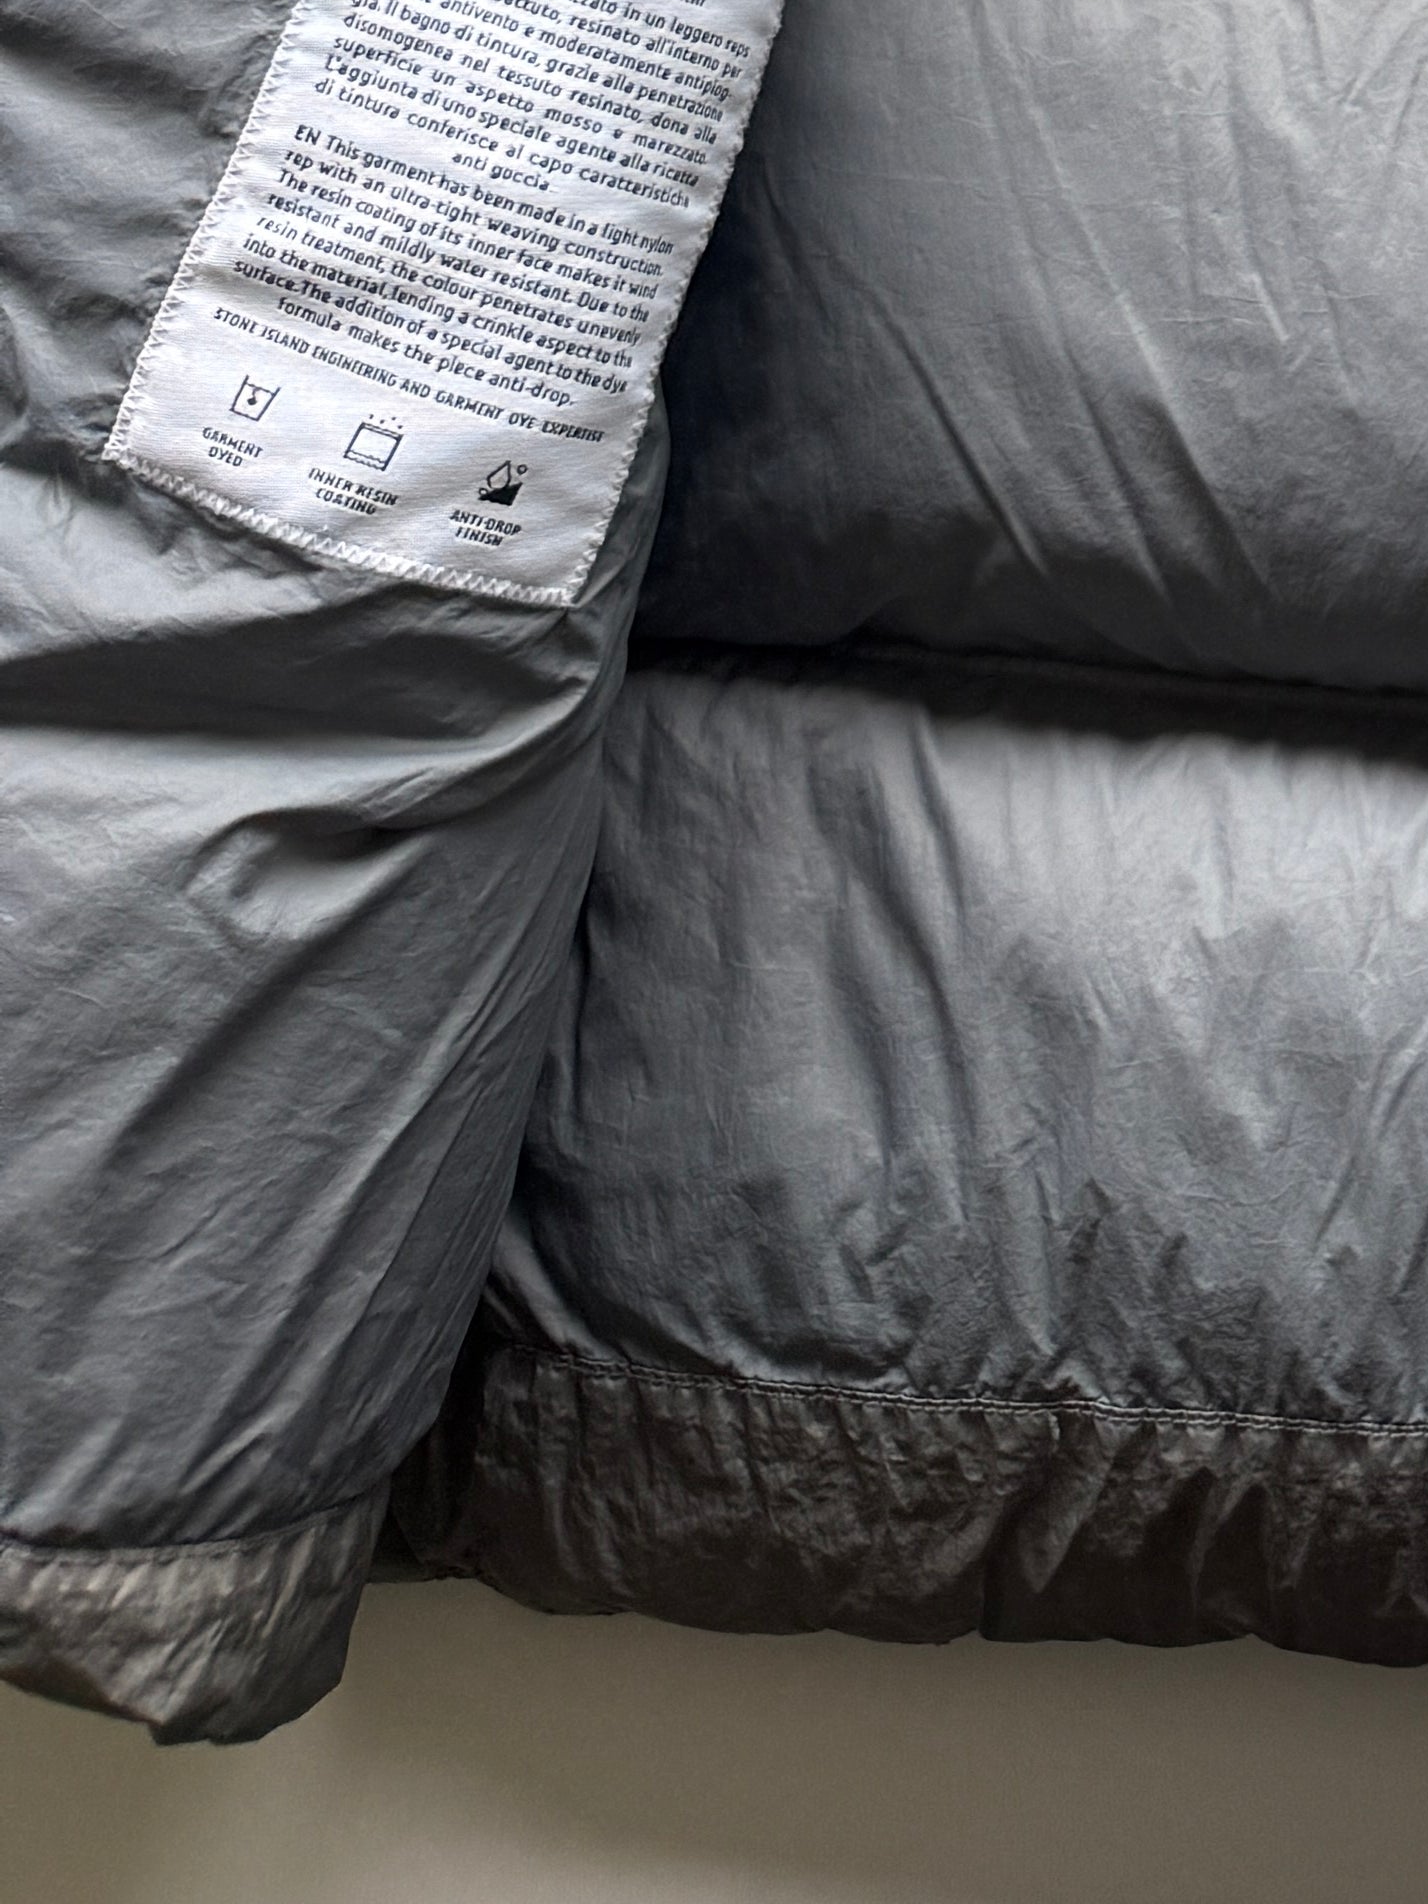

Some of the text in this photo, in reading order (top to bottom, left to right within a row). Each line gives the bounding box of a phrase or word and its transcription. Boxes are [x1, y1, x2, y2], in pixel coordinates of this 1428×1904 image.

[333, 37, 423, 75] superficie
[431, 69, 456, 86] un
[465, 81, 534, 113] aspetto
[543, 108, 603, 134] mosso
[343, 12, 717, 145] disomogenea nel tessuto resinato, dona alla
[385, 0, 399, 16] Il
[400, 5, 451, 35] bagno
[454, 25, 474, 42] di
[476, 33, 540, 67] tintura,
[545, 58, 599, 83] grazie
[602, 74, 635, 94] alla
[635, 85, 723, 122] penetrazione
[523, 26, 535, 38] e
[538, 30, 671, 80] moderatamente
[569, 16, 641, 46] resinato
[721, 63, 742, 78] per
[623, 2, 641, 21] in
[644, 13, 666, 29] un
[670, 17, 723, 47] leggero
[725, 39, 750, 58] reps
[314, 78, 335, 95] di
[338, 87, 400, 119] tintura
[407, 113, 498, 152] conferisce
[505, 145, 524, 159] al
[529, 153, 574, 175] capo
[324, 53, 418, 100] L'aggiunta
[421, 89, 441, 106] di
[442, 98, 477, 119] uno
[478, 111, 551, 143] speciale
[556, 136, 617, 163] agente
[619, 153, 650, 172] alla
[452, 153, 487, 171] anti
[278, 168, 308, 193] The
[311, 185, 352, 207] resin
[355, 201, 417, 233] coating
[419, 222, 439, 237] of
[439, 225, 463, 245] its
[467, 233, 515, 260] inner
[516, 248, 553, 272] face
[556, 264, 611, 288] makes
[613, 275, 626, 291] it
[284, 150, 661, 276] rep with an ultra-tight weaving construction.
[294, 124, 674, 254] EN This garment has been made in a light nylon
[243, 238, 276, 258] into
[279, 250, 309, 271] the
[457, 312, 470, 325] a
[472, 315, 534, 343] crinkle
[535, 335, 593, 359] aspect
[594, 348, 611, 364] to
[257, 217, 641, 346] resin treatment, the colour penetrates unevenly
[266, 193, 340, 228] resistant
[343, 222, 378, 242] and
[379, 235, 436, 264] mildly
[440, 254, 488, 278] water
[491, 271, 572, 303] resistant.
[576, 291, 609, 312] Due
[613, 302, 628, 317] to
[213, 307, 258, 334] STONE
[260, 326, 310, 354] ISLAND
[311, 345, 397, 387] ENGINEERING
[399, 378, 431, 398] AND
[434, 390, 505, 420] GARMENT
[277, 296, 573, 407] formula makes the piece anti-drop.
[406, 320, 427, 335] of
[427, 329, 438, 340] a
[441, 332, 503, 360] special
[504, 352, 554, 375] agent
[555, 364, 573, 380] to
[574, 368, 601, 387] the
